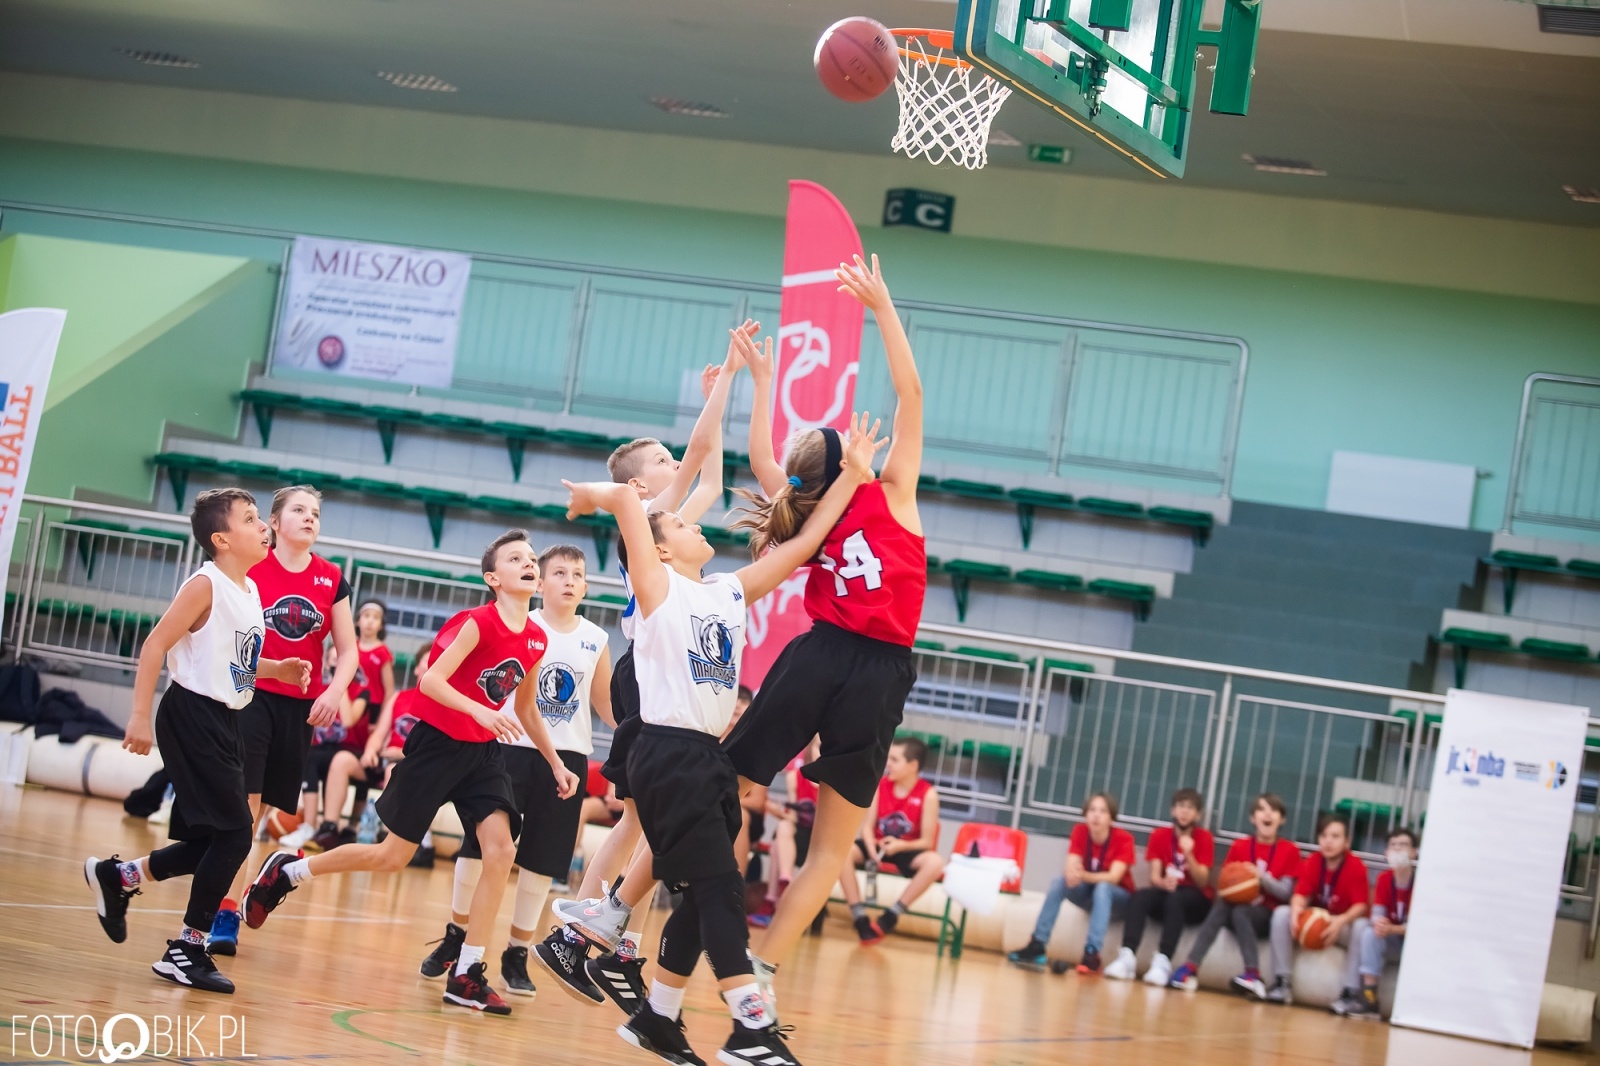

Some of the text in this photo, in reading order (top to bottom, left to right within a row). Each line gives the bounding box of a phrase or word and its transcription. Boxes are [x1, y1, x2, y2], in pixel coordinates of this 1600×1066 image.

[915, 203, 946, 228] C
[311, 249, 447, 288] MIESZKO
[265, 607, 289, 618] HOUSTON
[301, 608, 323, 623] ROCKETS
[1477, 751, 1506, 778] nba
[550, 942, 574, 975] adidas
